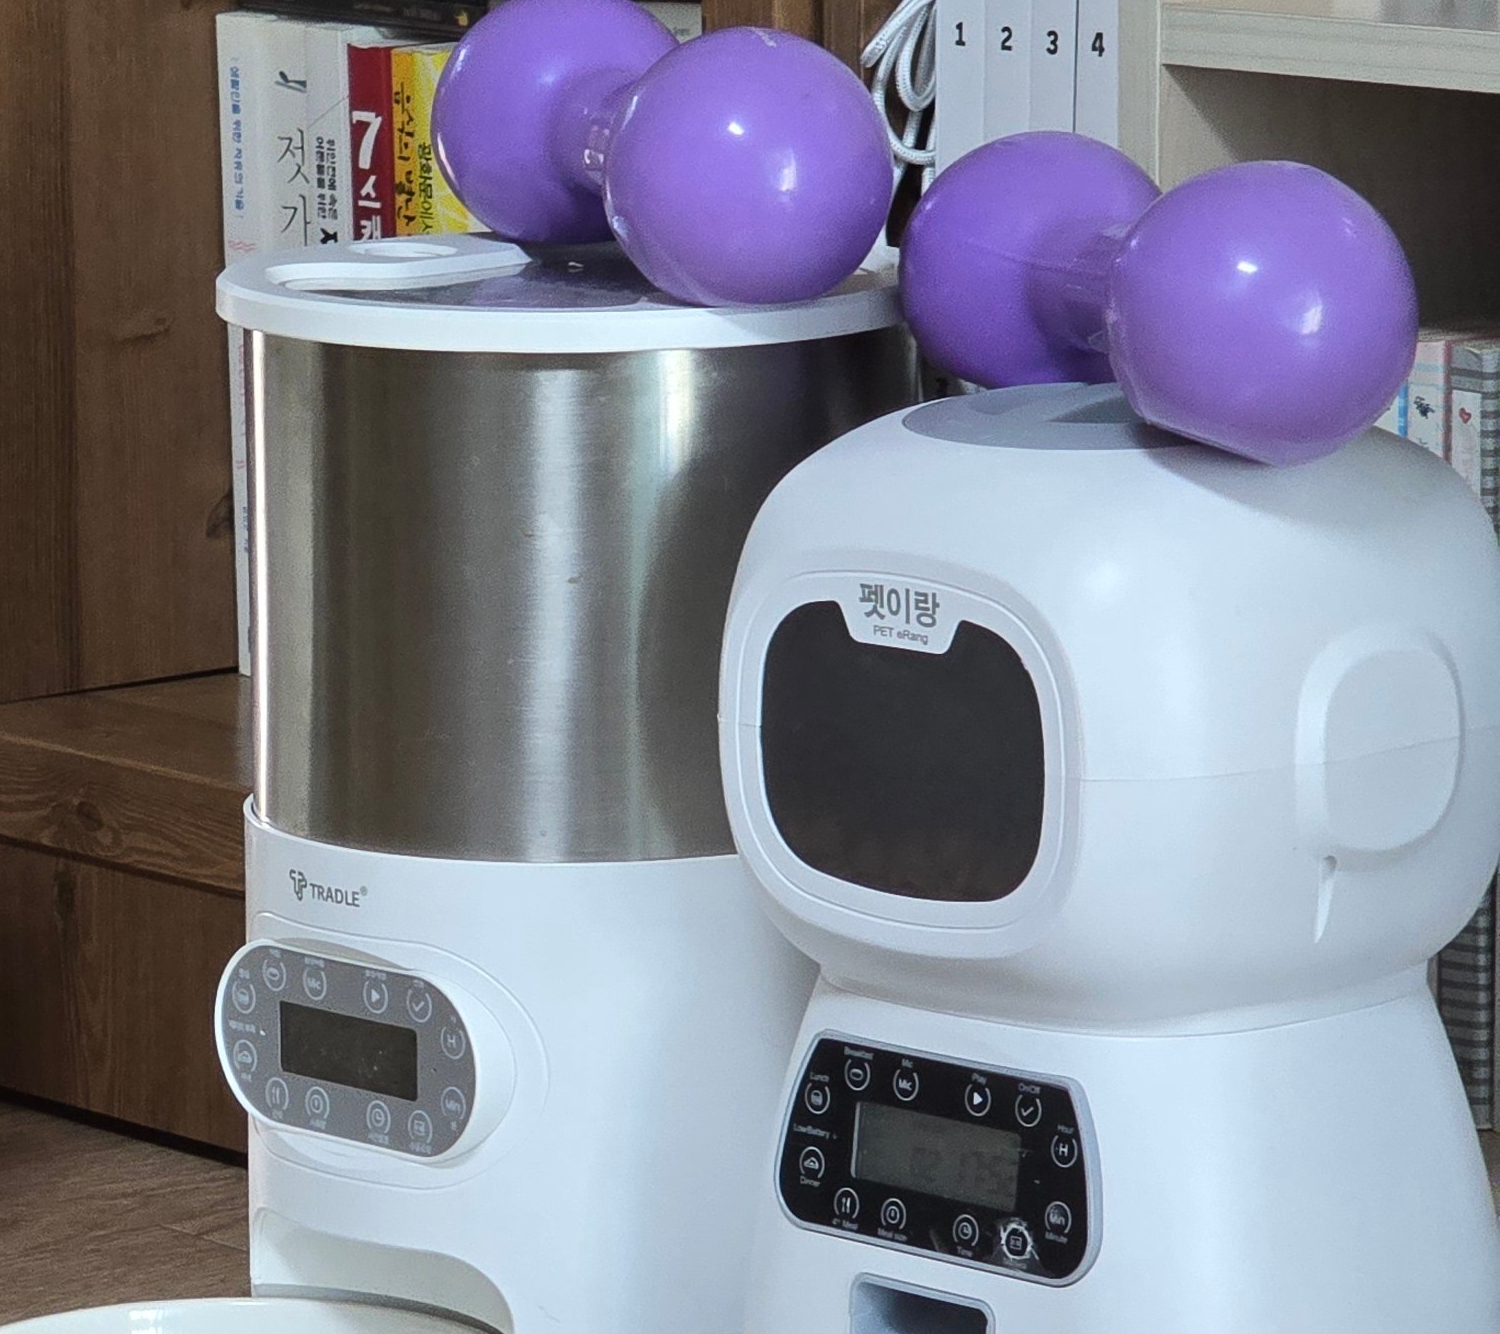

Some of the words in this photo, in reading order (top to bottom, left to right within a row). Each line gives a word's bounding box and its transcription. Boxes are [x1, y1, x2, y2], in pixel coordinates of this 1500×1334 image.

[955, 21, 967, 47] 1
[1000, 26, 1013, 52] 2
[1045, 30, 1060, 56] 3
[1090, 32, 1106, 58] 4
[393, 81, 415, 161] 음식의
[352, 110, 382, 170] 7
[858, 582, 941, 629] 펫이랑
[872, 624, 895, 639] PET
[896, 628, 929, 646] eRang
[309, 882, 360, 909] TRADLE
[1058, 1144, 1069, 1156] H
